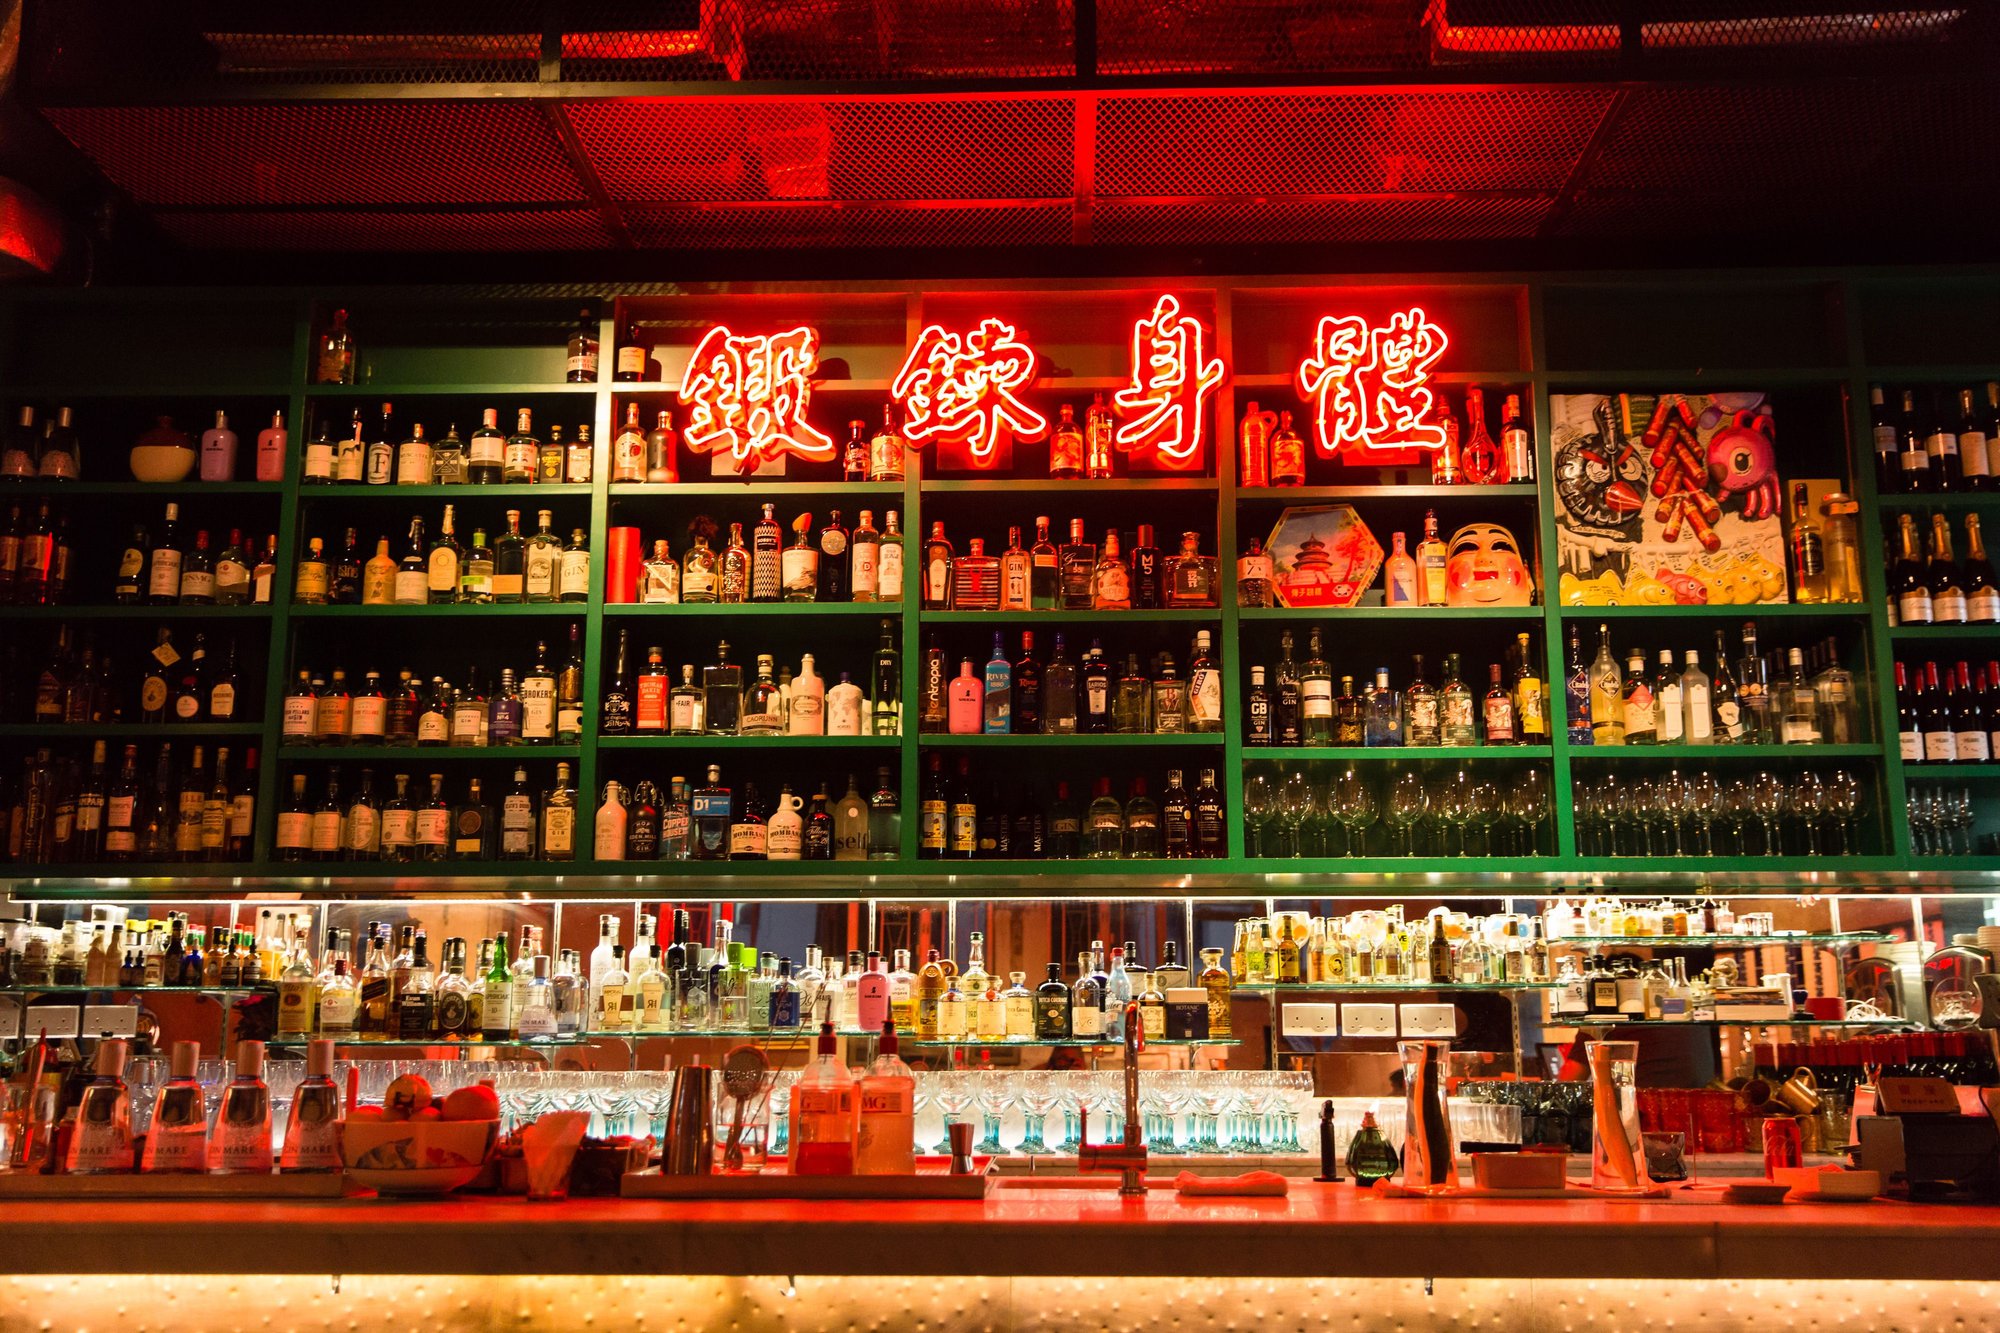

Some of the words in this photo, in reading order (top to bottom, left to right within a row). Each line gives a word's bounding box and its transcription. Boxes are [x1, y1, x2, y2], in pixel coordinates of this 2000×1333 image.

[374, 452, 386, 473] F
[563, 563, 585, 576] GIN
[1008, 563, 1023, 571] GIN
[986, 672, 1010, 681] RIVES
[1250, 702, 1268, 715] GB
[746, 715, 779, 723] CAORUNN
[693, 798, 710, 811] D1
[1164, 805, 1185, 813] ONLY
[1198, 804, 1220, 813] ONLY
[1055, 822, 1075, 831] GIN
[836, 831, 867, 850] self
[862, 1096, 887, 1110] MG
[224, 1146, 254, 1154] MARE
[301, 1145, 332, 1154] MARE
